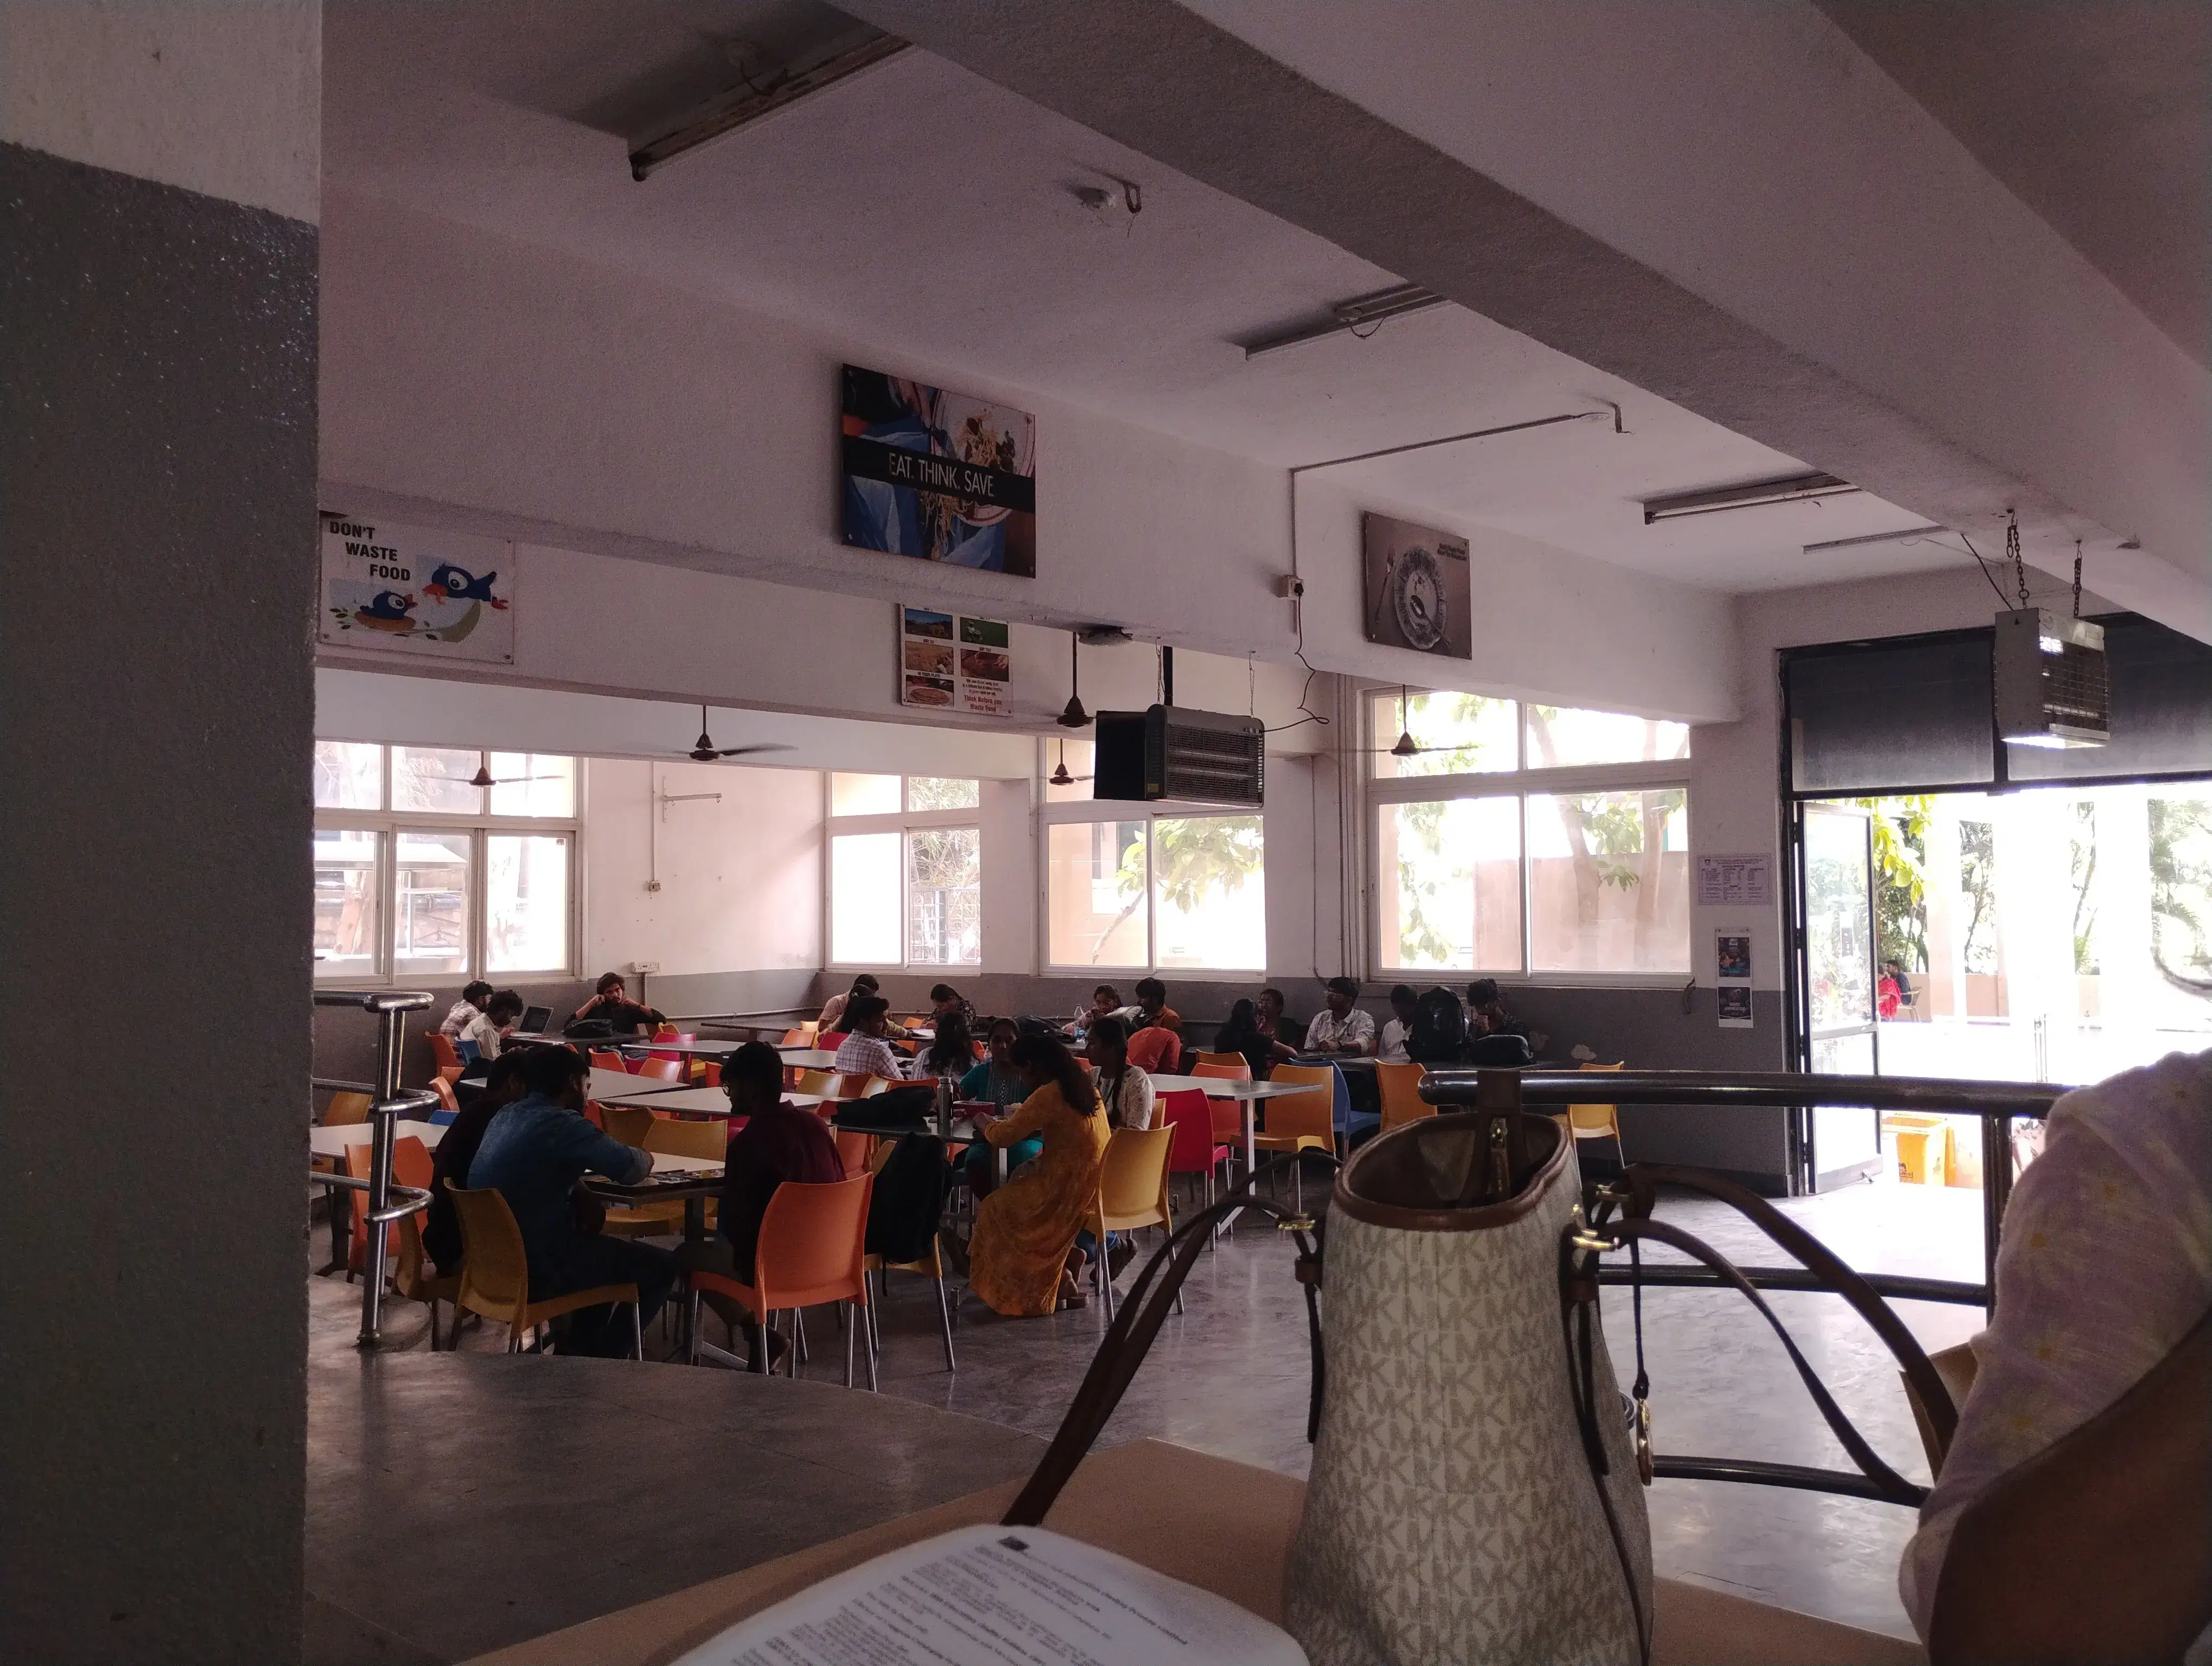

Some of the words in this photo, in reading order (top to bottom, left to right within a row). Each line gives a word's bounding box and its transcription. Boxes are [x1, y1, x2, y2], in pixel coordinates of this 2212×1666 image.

[918, 459, 961, 490] THINK.
[964, 469, 996, 497] SAVE
[330, 521, 376, 540] DON'T
[345, 542, 398, 562] WASTE
[369, 563, 411, 581] FOOD
